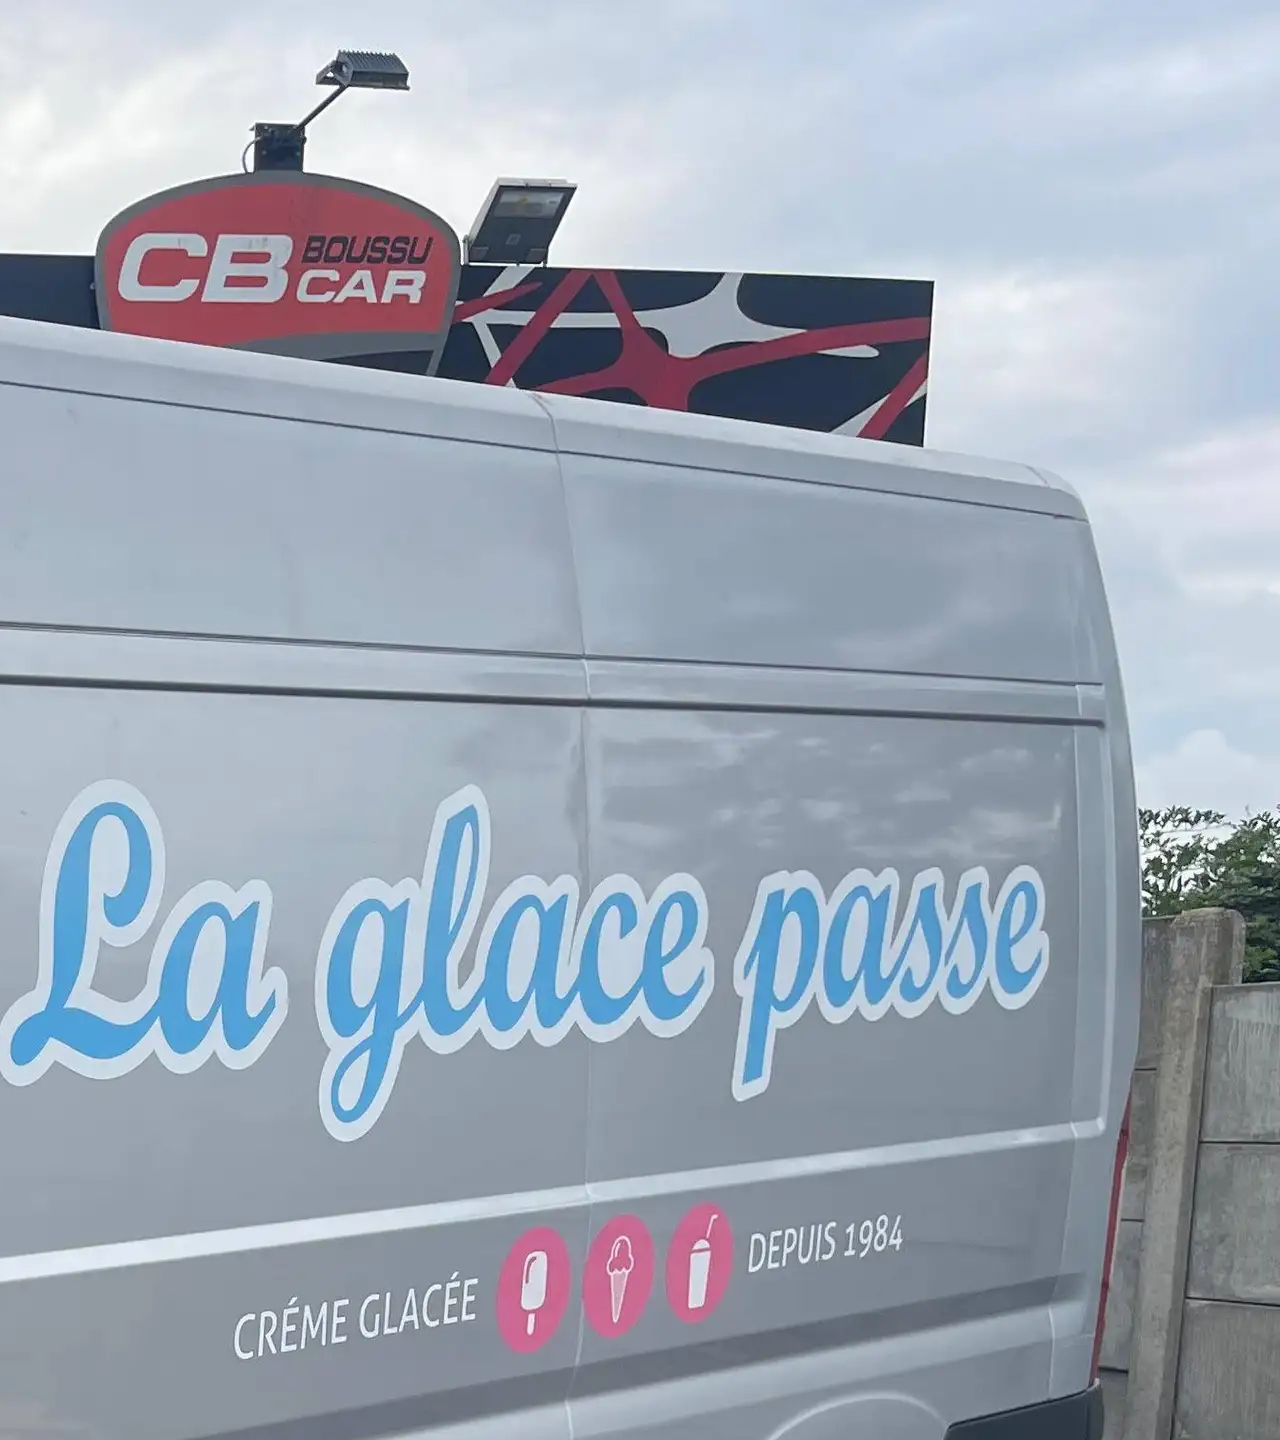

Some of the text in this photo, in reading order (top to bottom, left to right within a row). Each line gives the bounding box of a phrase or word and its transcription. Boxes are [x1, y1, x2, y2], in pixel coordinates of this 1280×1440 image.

[118, 233, 427, 304] CB CAR
[301, 235, 433, 265] BOUSSU
[3, 792, 1044, 1132] La glace passe
[747, 1213, 904, 1274] DEPUIS 1984
[233, 1272, 479, 1361] CRÉME GLACÉE
